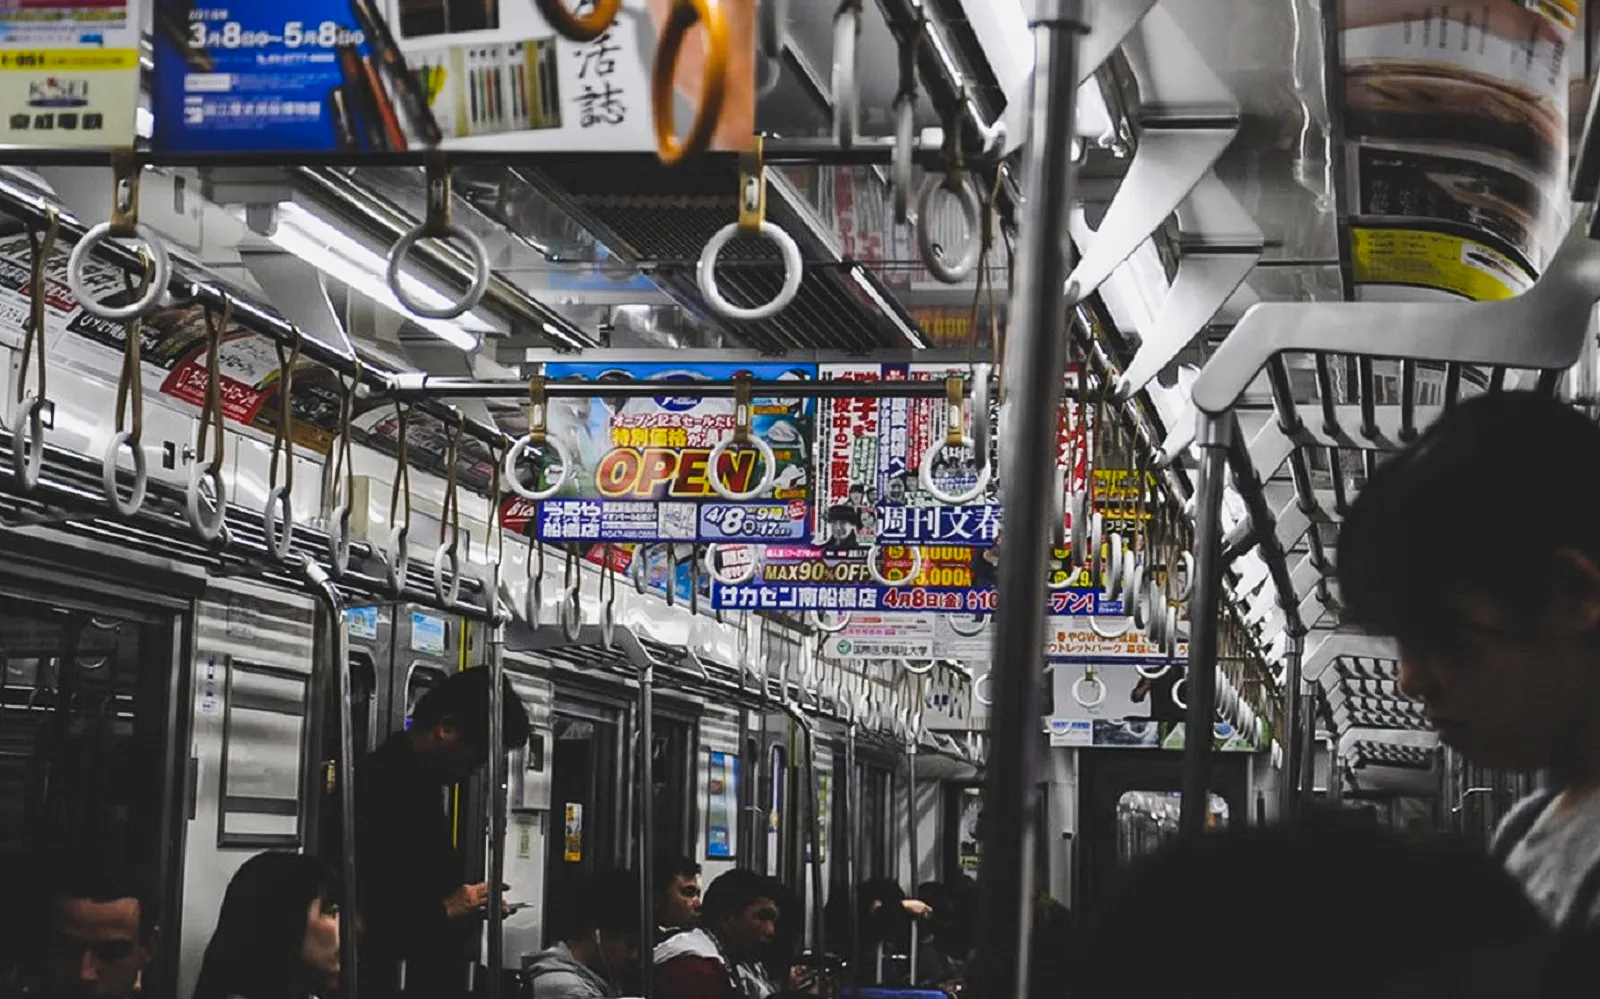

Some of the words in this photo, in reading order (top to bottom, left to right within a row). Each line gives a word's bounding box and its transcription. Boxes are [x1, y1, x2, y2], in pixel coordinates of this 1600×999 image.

[596, 448, 756, 498] OPEN
[878, 506, 1000, 539] 週刊文春
[720, 586, 878, 607] サカゼン南船橋店
